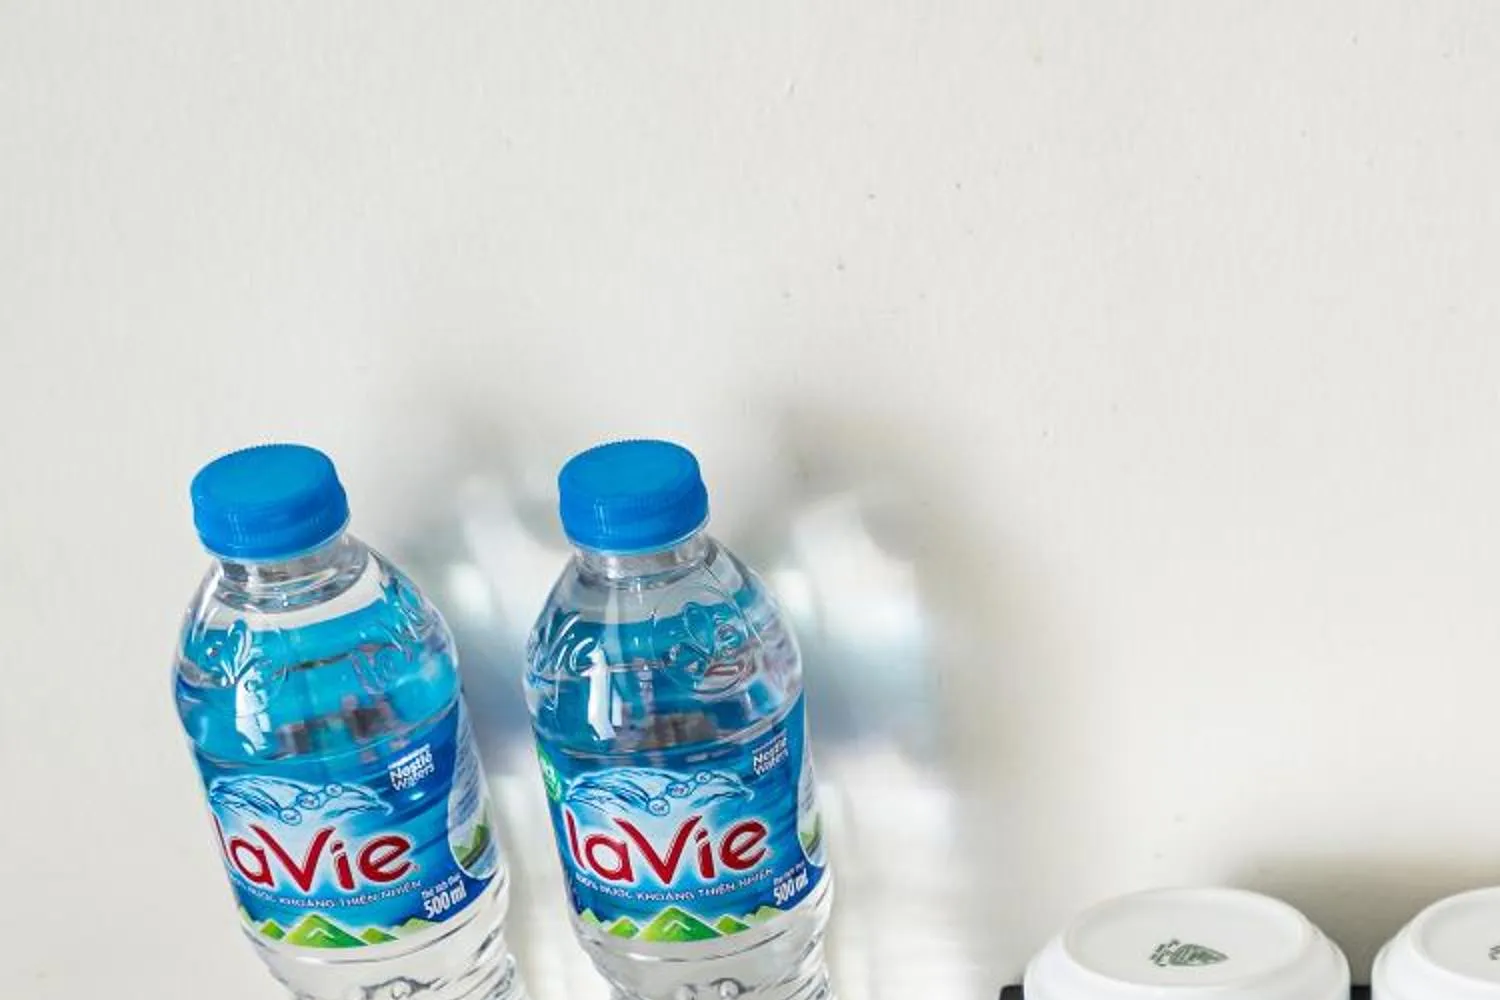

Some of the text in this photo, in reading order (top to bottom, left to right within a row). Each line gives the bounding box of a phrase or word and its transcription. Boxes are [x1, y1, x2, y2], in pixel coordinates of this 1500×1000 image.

[212, 813, 411, 891] aVie
[565, 810, 769, 886] laVie
[423, 891, 450, 919] 500
